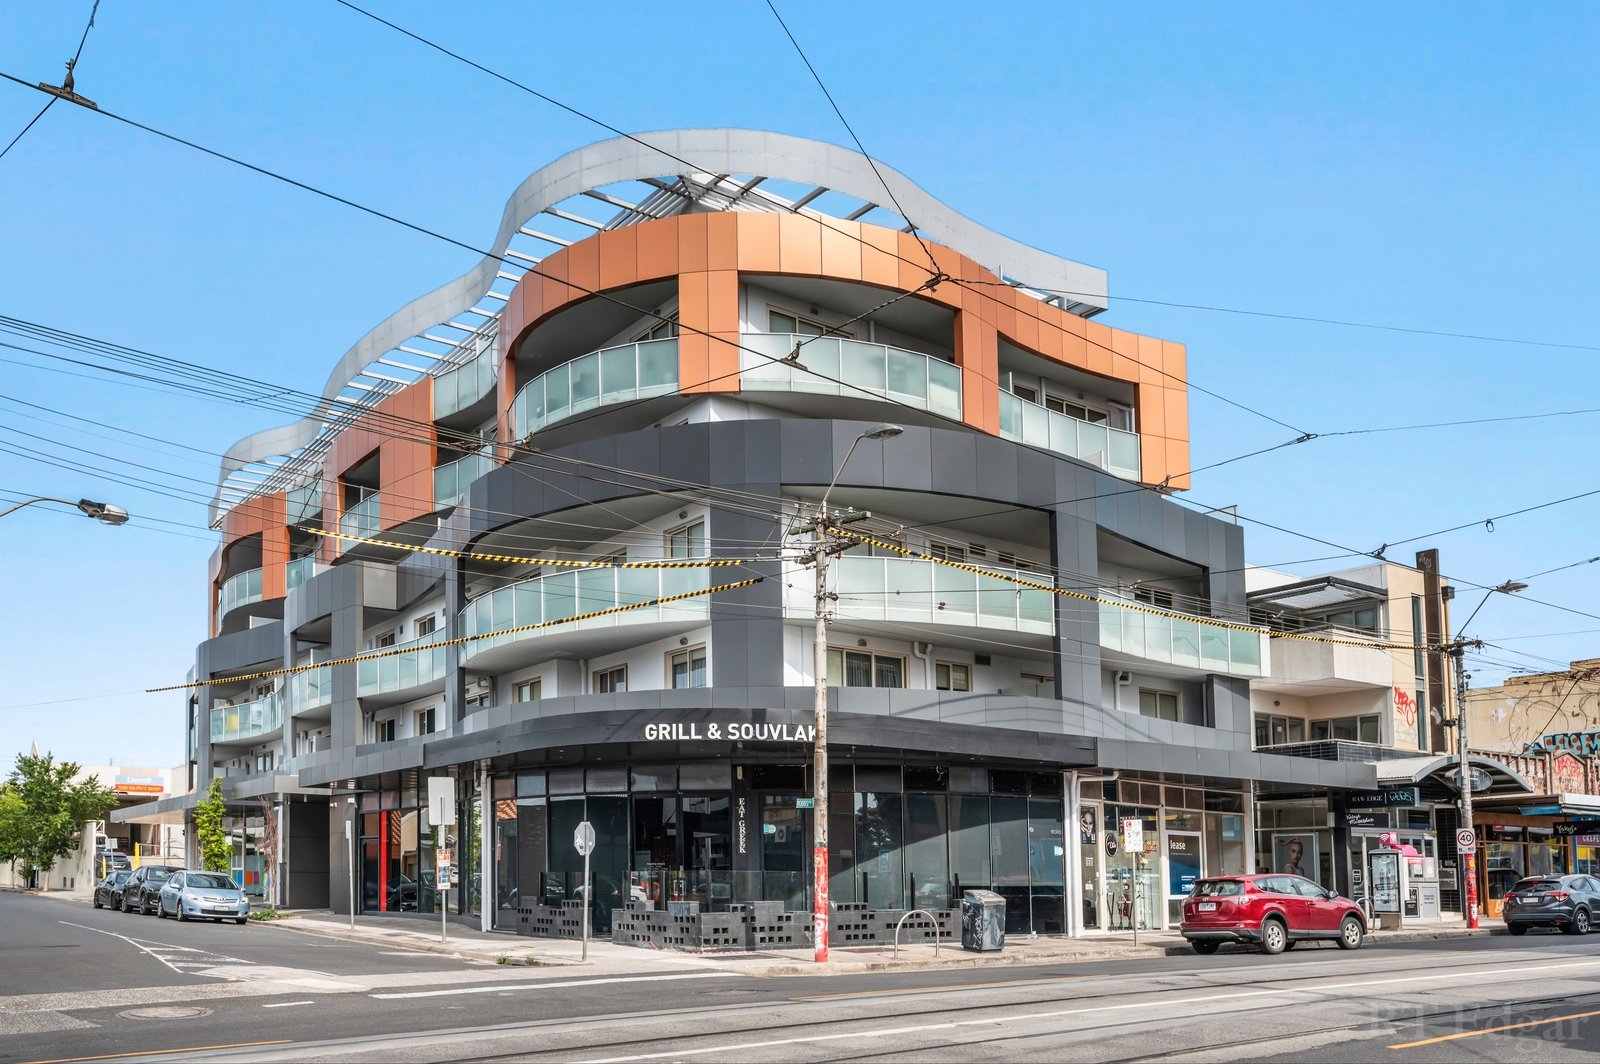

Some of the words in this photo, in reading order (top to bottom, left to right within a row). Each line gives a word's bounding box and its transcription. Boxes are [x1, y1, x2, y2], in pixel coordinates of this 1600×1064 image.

[645, 723, 702, 740] GRILL
[707, 723, 721, 739] &
[727, 723, 816, 742] SOUVLAK
[738, 797, 746, 818] EAT
[738, 820, 746, 853] GREEK
[1170, 839, 1186, 850] lease
[1460, 834, 1472, 842] 40
